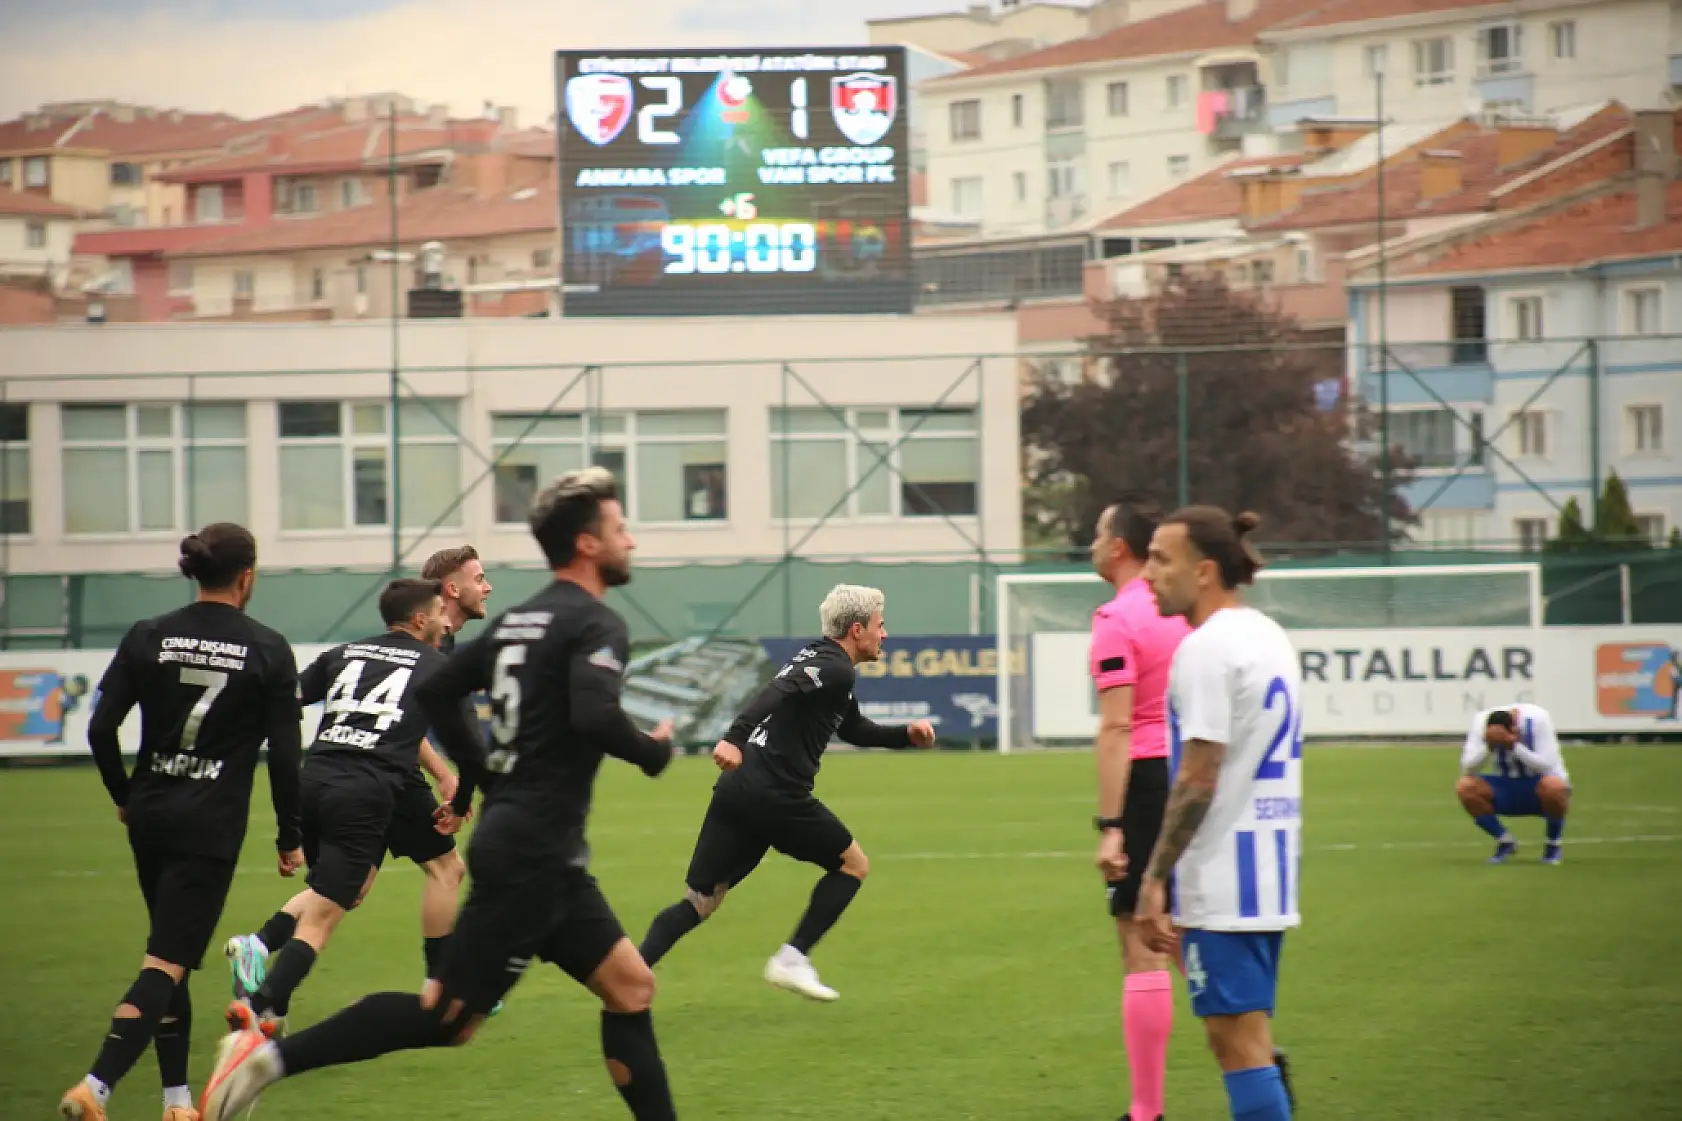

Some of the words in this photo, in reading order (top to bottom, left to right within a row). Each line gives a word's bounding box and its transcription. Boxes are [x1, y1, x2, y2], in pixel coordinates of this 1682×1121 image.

[637, 76, 682, 143] 2
[790, 77, 808, 139] 1
[576, 168, 667, 187] ANKARA
[668, 167, 726, 185] SPOR
[757, 165, 804, 183] VAN
[806, 165, 864, 183] SPOR
[866, 165, 895, 183] FK
[818, 146, 894, 165] GROUP
[661, 223, 816, 274] 90:00
[179, 667, 229, 750] 7
[324, 659, 412, 731] 44
[491, 643, 528, 744] 5
